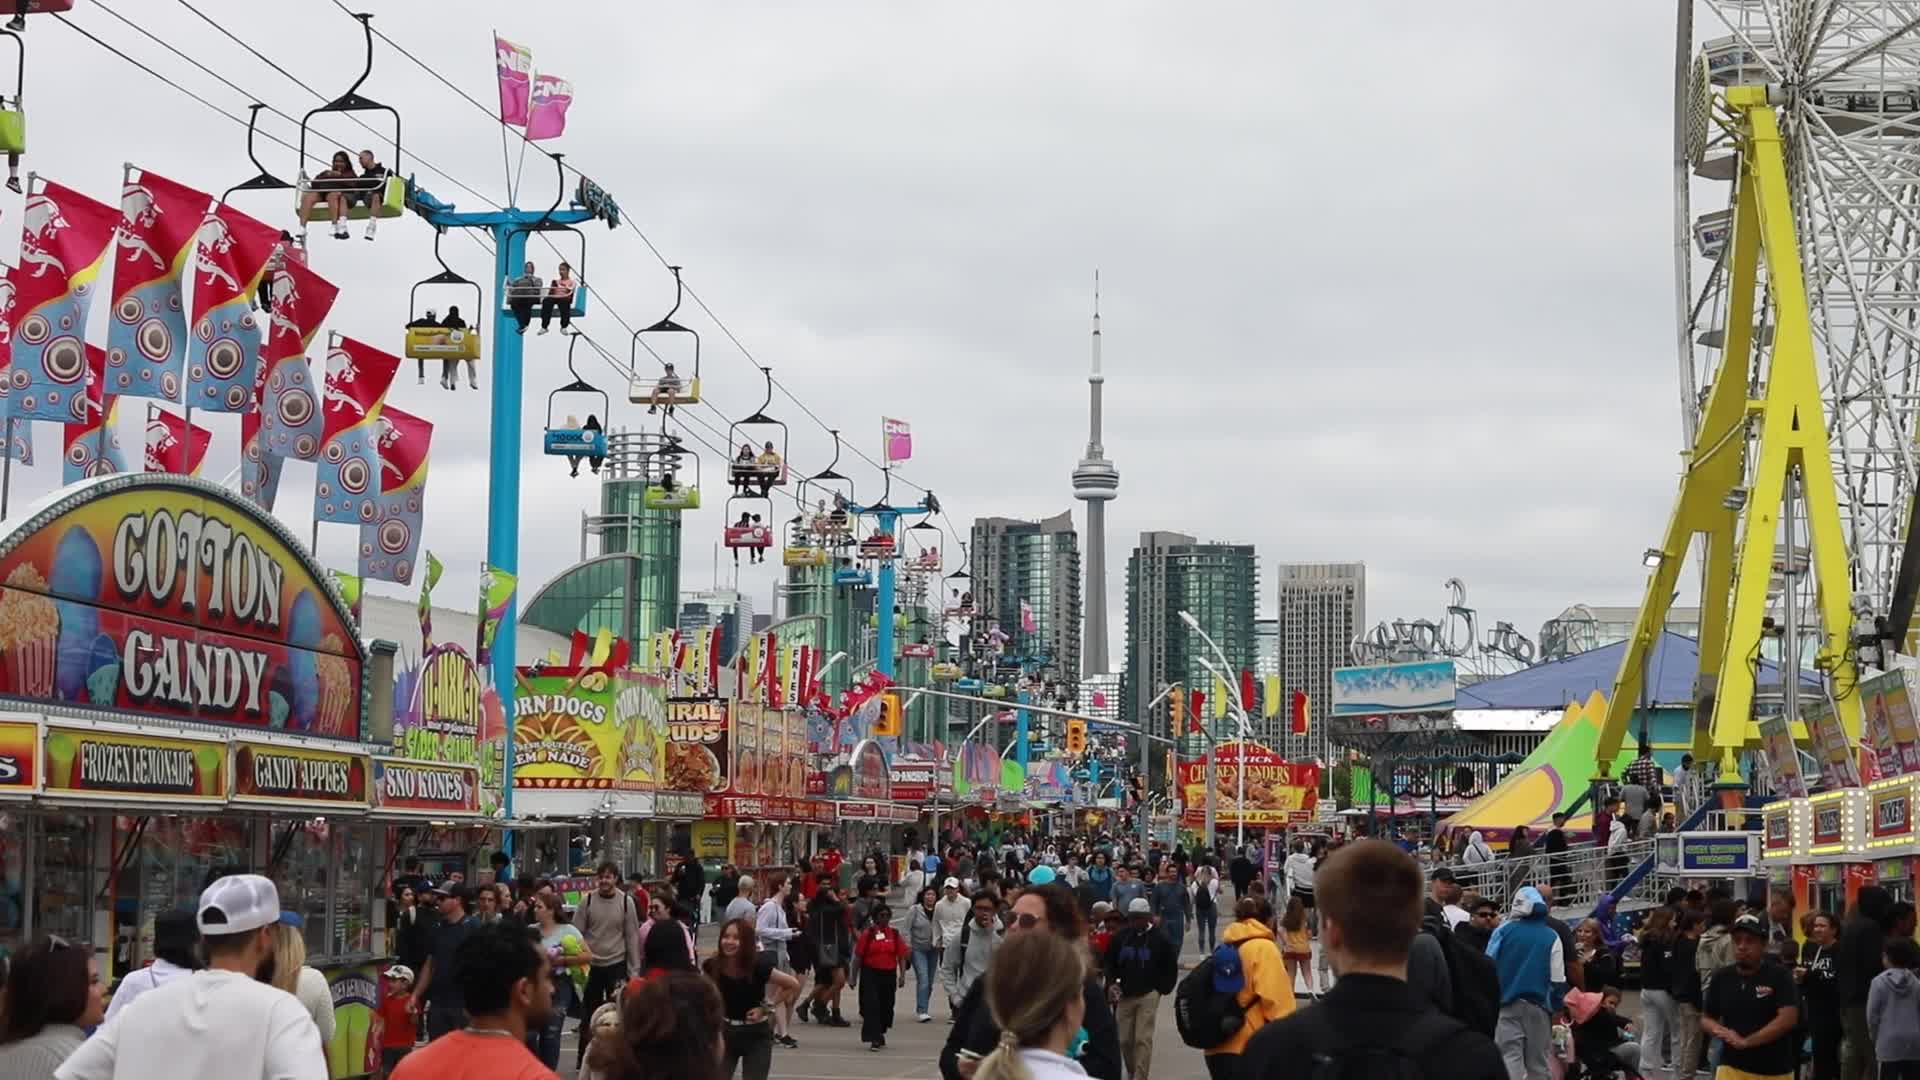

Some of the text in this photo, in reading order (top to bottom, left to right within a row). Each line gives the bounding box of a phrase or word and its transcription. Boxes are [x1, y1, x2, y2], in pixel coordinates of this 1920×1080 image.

[114, 507, 284, 629] COTTON
[124, 630, 270, 713] CANDY
[790, 649, 799, 702] FRIES
[513, 695, 606, 724] RN DOGS
[667, 703, 721, 721] IRAL
[669, 725, 719, 742] UDS
[81, 741, 194, 787] FROZEN LEMONADE
[255, 755, 348, 793] CANDY APPLES
[1190, 764, 1238, 783] CHKEN
[387, 767, 463, 801] SNO KONES
